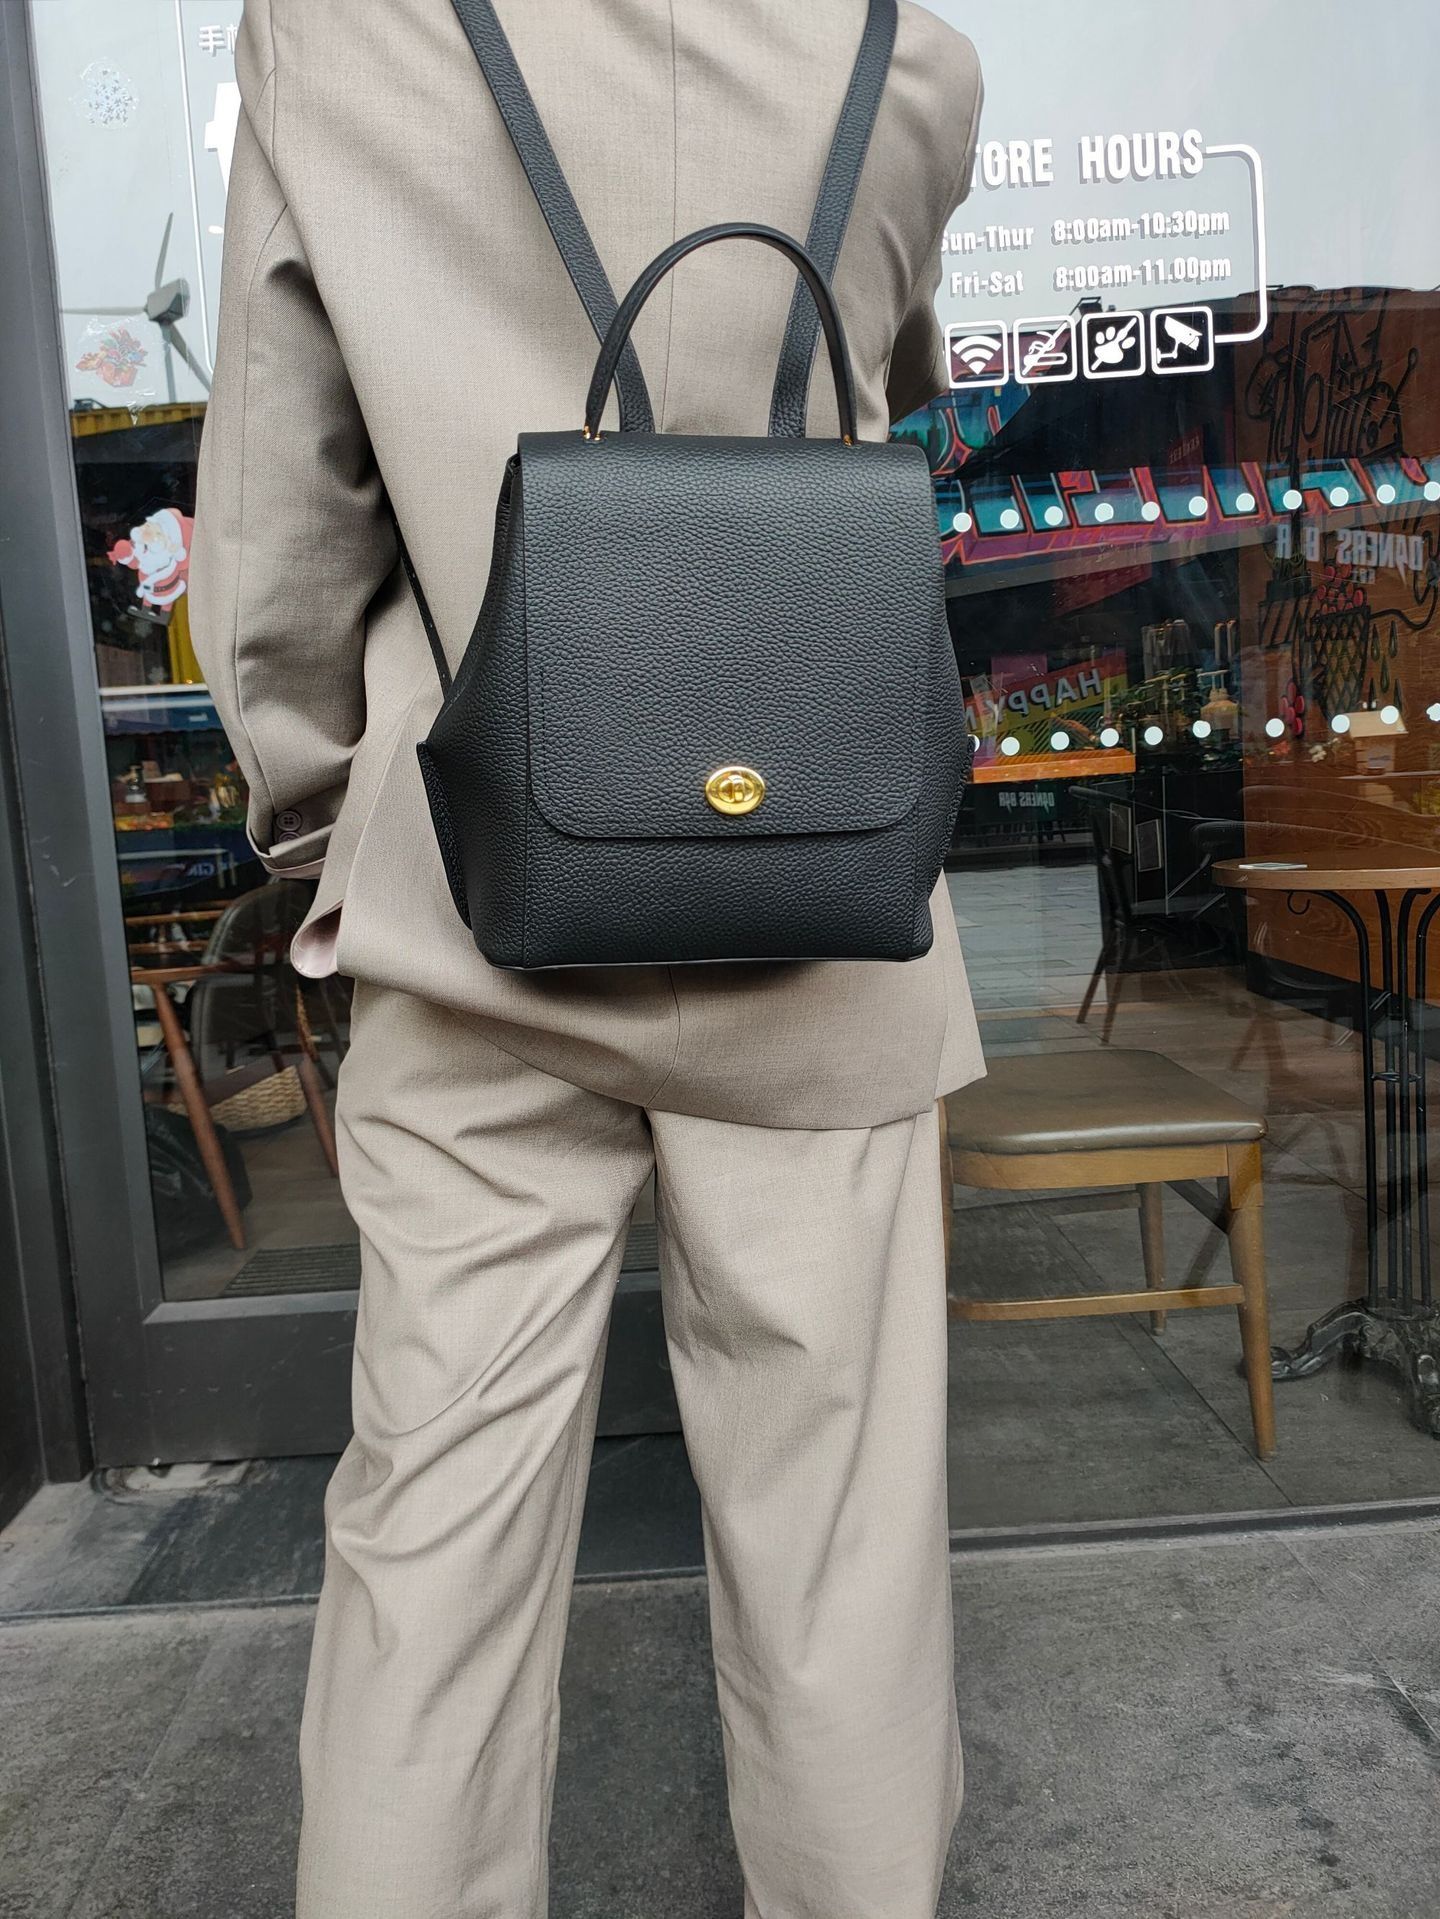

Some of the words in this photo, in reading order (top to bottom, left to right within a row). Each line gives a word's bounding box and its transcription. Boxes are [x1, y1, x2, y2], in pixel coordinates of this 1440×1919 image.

[1080, 128, 1204, 180] HOURS
[1053, 209, 1231, 242] 8:00am-10:30pm
[951, 270, 1024, 294] Fri-Sat
